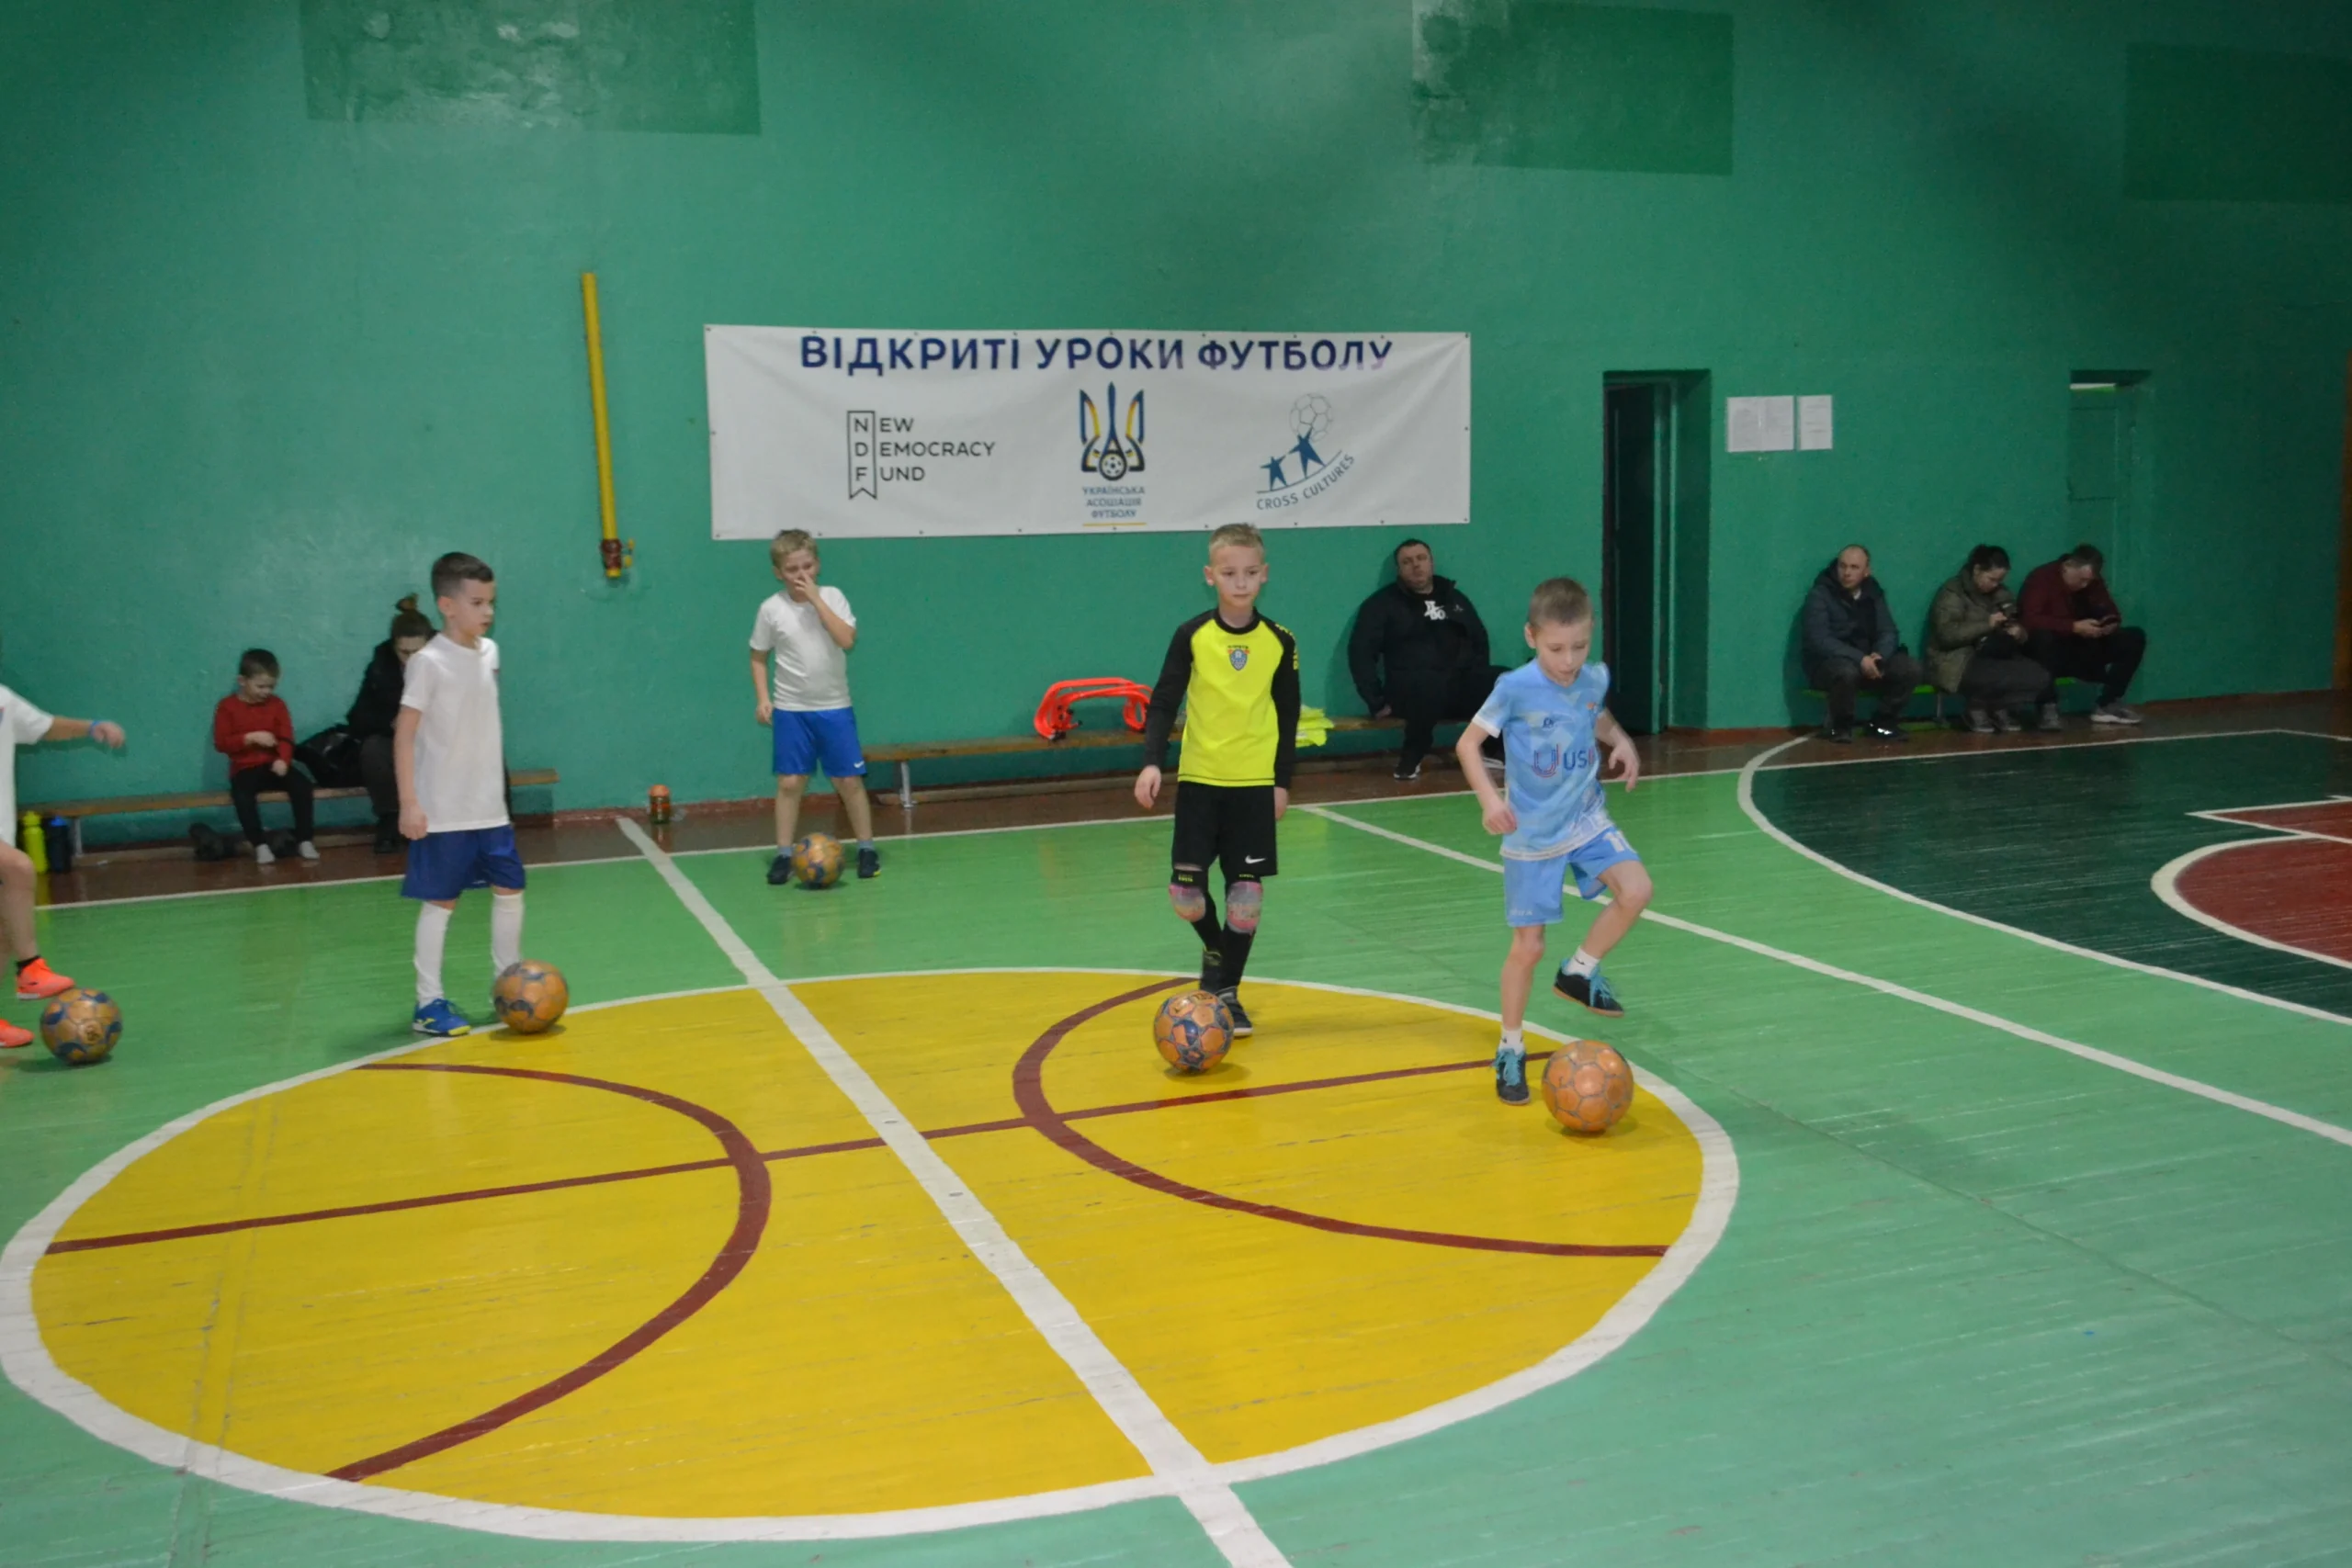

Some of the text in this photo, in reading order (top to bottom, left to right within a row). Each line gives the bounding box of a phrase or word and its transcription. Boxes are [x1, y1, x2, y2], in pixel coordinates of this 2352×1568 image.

[800, 335, 1393, 377] ВІДКРИТІ УРОКИ ФУТБОЛУ
[1256, 454, 1355, 511] CROSS CULTURES
